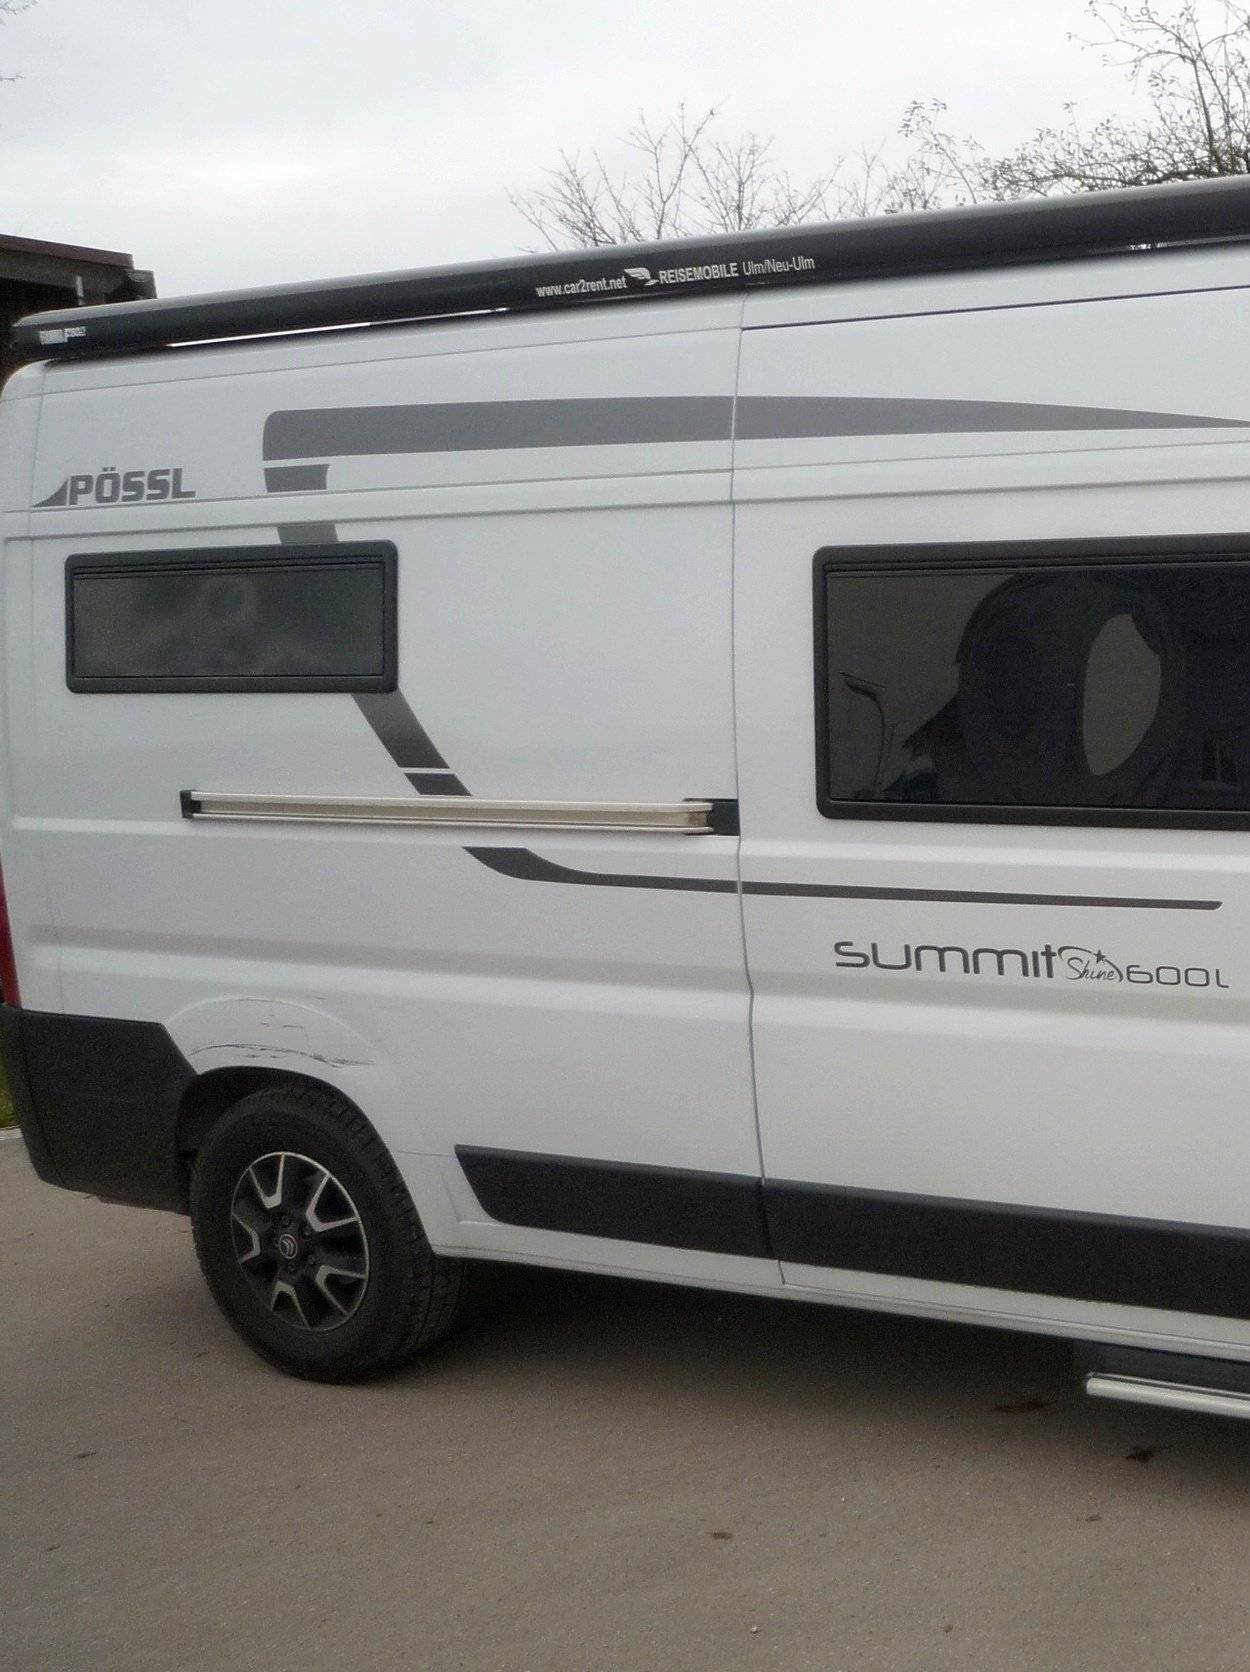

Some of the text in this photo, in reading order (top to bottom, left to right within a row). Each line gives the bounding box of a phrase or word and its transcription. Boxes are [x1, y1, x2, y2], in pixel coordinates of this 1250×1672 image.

[535, 255, 816, 297] www.car2rent.net REISEMOBILE Ulm/Neu-Ulm
[68, 466, 196, 506] PÖSSL
[1065, 956, 1117, 981] Shine
[1125, 964, 1230, 989] 600L
